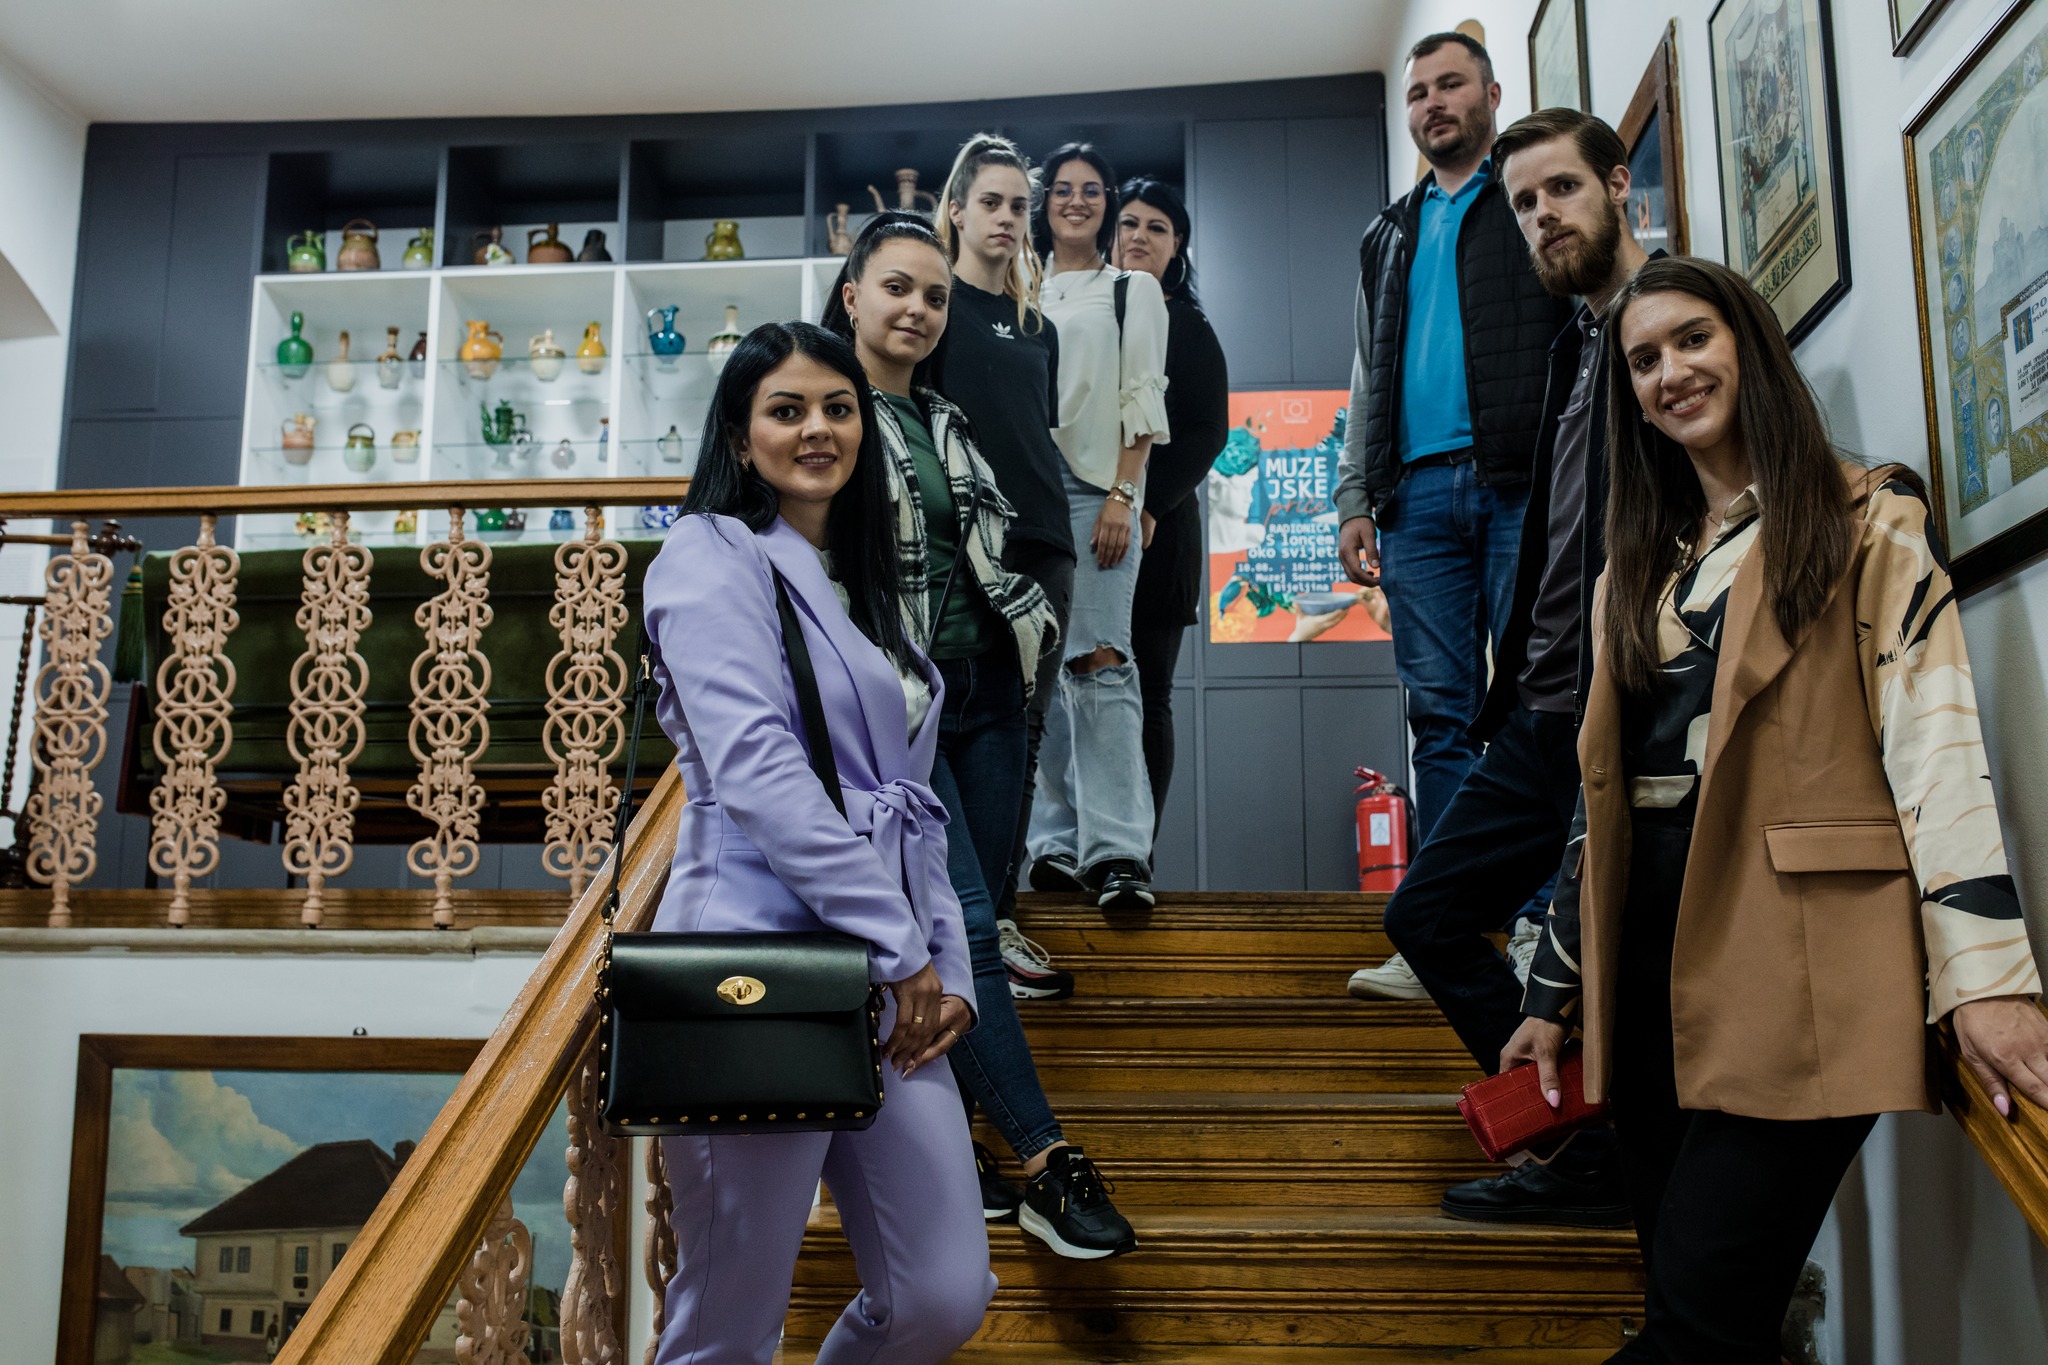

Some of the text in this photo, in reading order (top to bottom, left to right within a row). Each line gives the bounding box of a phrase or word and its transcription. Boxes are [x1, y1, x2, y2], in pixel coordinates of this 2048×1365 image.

[1266, 457, 1327, 478] MUZE
[1268, 478, 1328, 499] JSKE
[1269, 523, 1331, 534] RADIONICA
[1266, 533, 1276, 546] S
[1248, 544, 1276, 559] oko
[1292, 561, 1348, 572] 10:00-12
[1255, 572, 1287, 584] Muzej
[1274, 582, 1329, 593] Bijeljina
